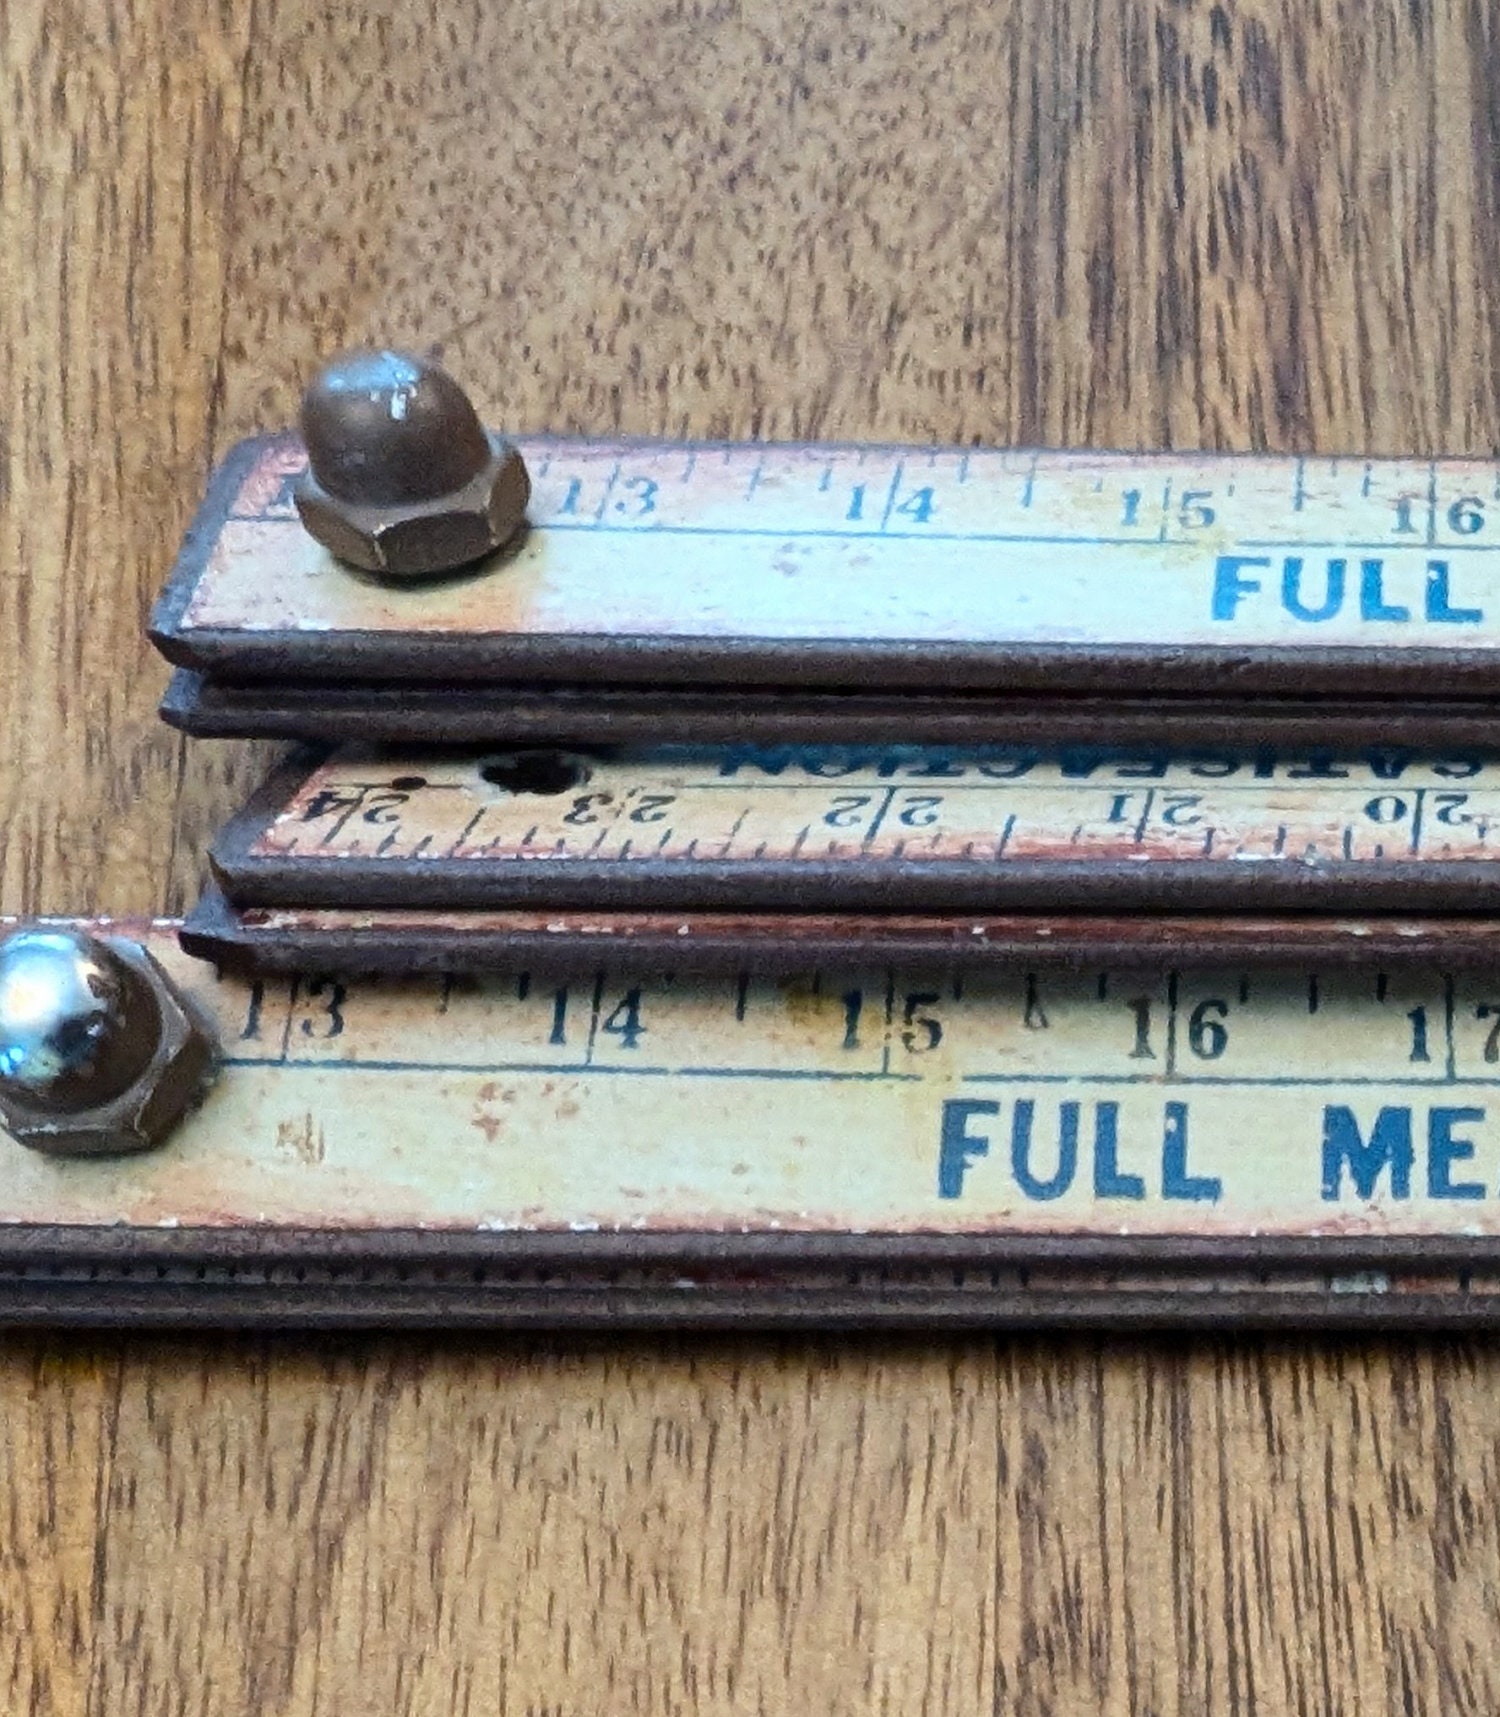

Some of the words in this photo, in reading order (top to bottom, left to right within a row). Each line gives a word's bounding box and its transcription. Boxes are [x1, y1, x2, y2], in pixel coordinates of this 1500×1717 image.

[558, 476, 659, 516] 13
[844, 483, 938, 525] 14
[1120, 488, 1217, 530] 15
[1389, 494, 1487, 535] 16
[1209, 554, 1485, 625] FULL
[822, 796, 945, 828] 22
[1108, 794, 1203, 826] 21
[1364, 794, 1473, 826] 20
[548, 985, 648, 1049] 14
[841, 990, 944, 1055] 15
[1126, 997, 1231, 1061] 16
[937, 1097, 1223, 1204] FULL
